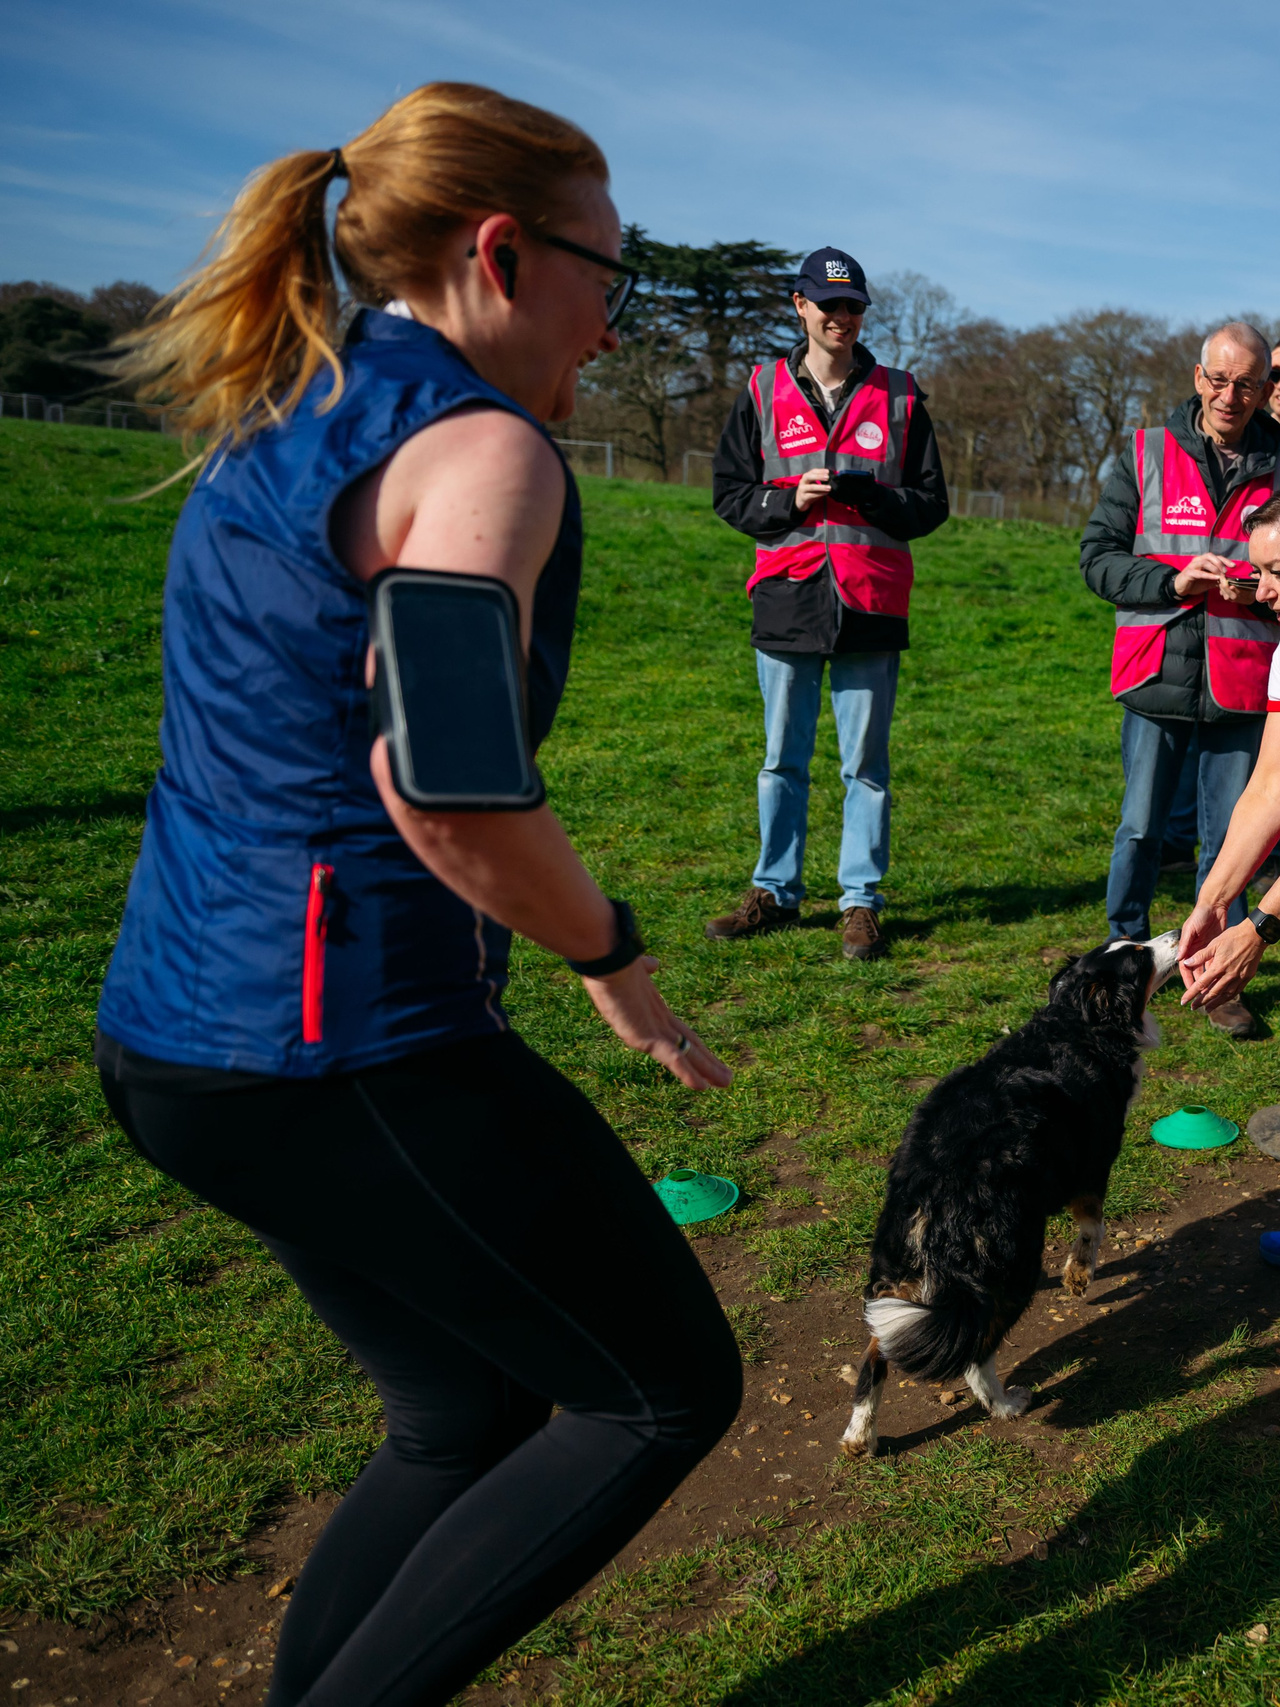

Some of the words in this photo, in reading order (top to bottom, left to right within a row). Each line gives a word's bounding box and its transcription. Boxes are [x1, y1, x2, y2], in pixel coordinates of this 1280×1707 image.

[826, 268, 850, 278] 200
[779, 418, 813, 440] parkrun
[781, 437, 817, 450] VOLUNTEER
[1166, 496, 1207, 515] parkrun
[1165, 518, 1207, 527] VOLUNTEER
